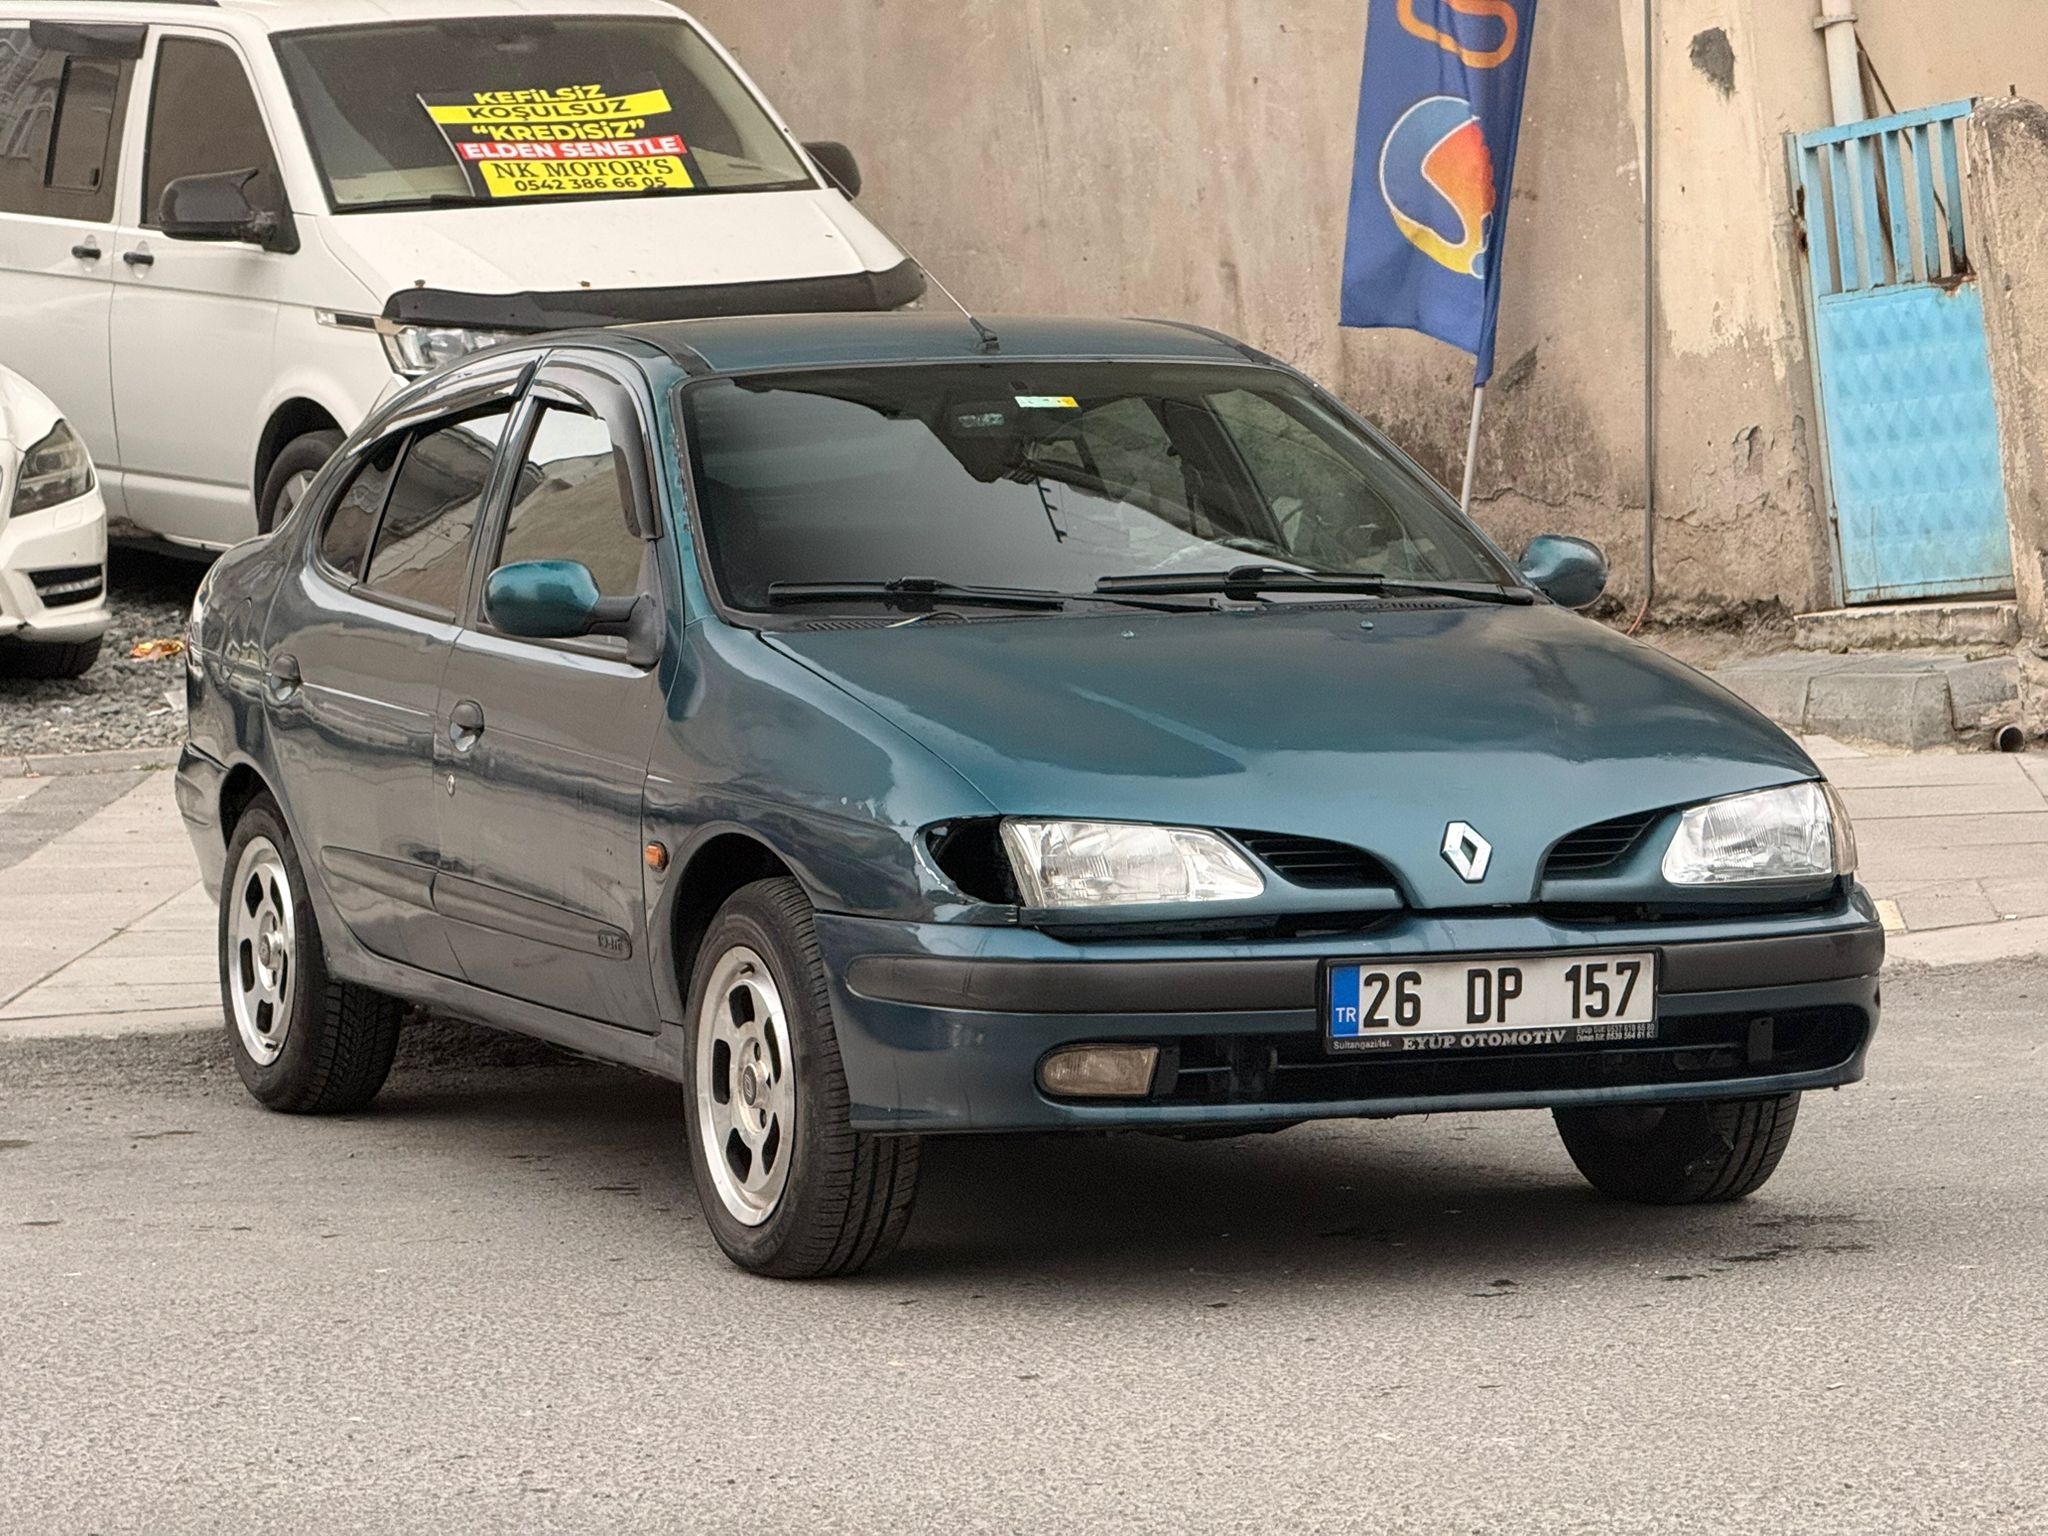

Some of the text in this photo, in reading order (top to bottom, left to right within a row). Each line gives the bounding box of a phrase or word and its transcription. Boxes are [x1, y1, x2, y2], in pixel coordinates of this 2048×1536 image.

[467, 99, 631, 121] KOŞULSUZ
[463, 136, 679, 159] ELDEN SENETLE
[491, 162, 540, 179] NK
[514, 176, 667, 191] 0542 386 66 05
[1363, 961, 1641, 1028] 26 DP 157
[1335, 1006, 1357, 1023] TR
[1402, 1033, 1457, 1051] EYÜP
